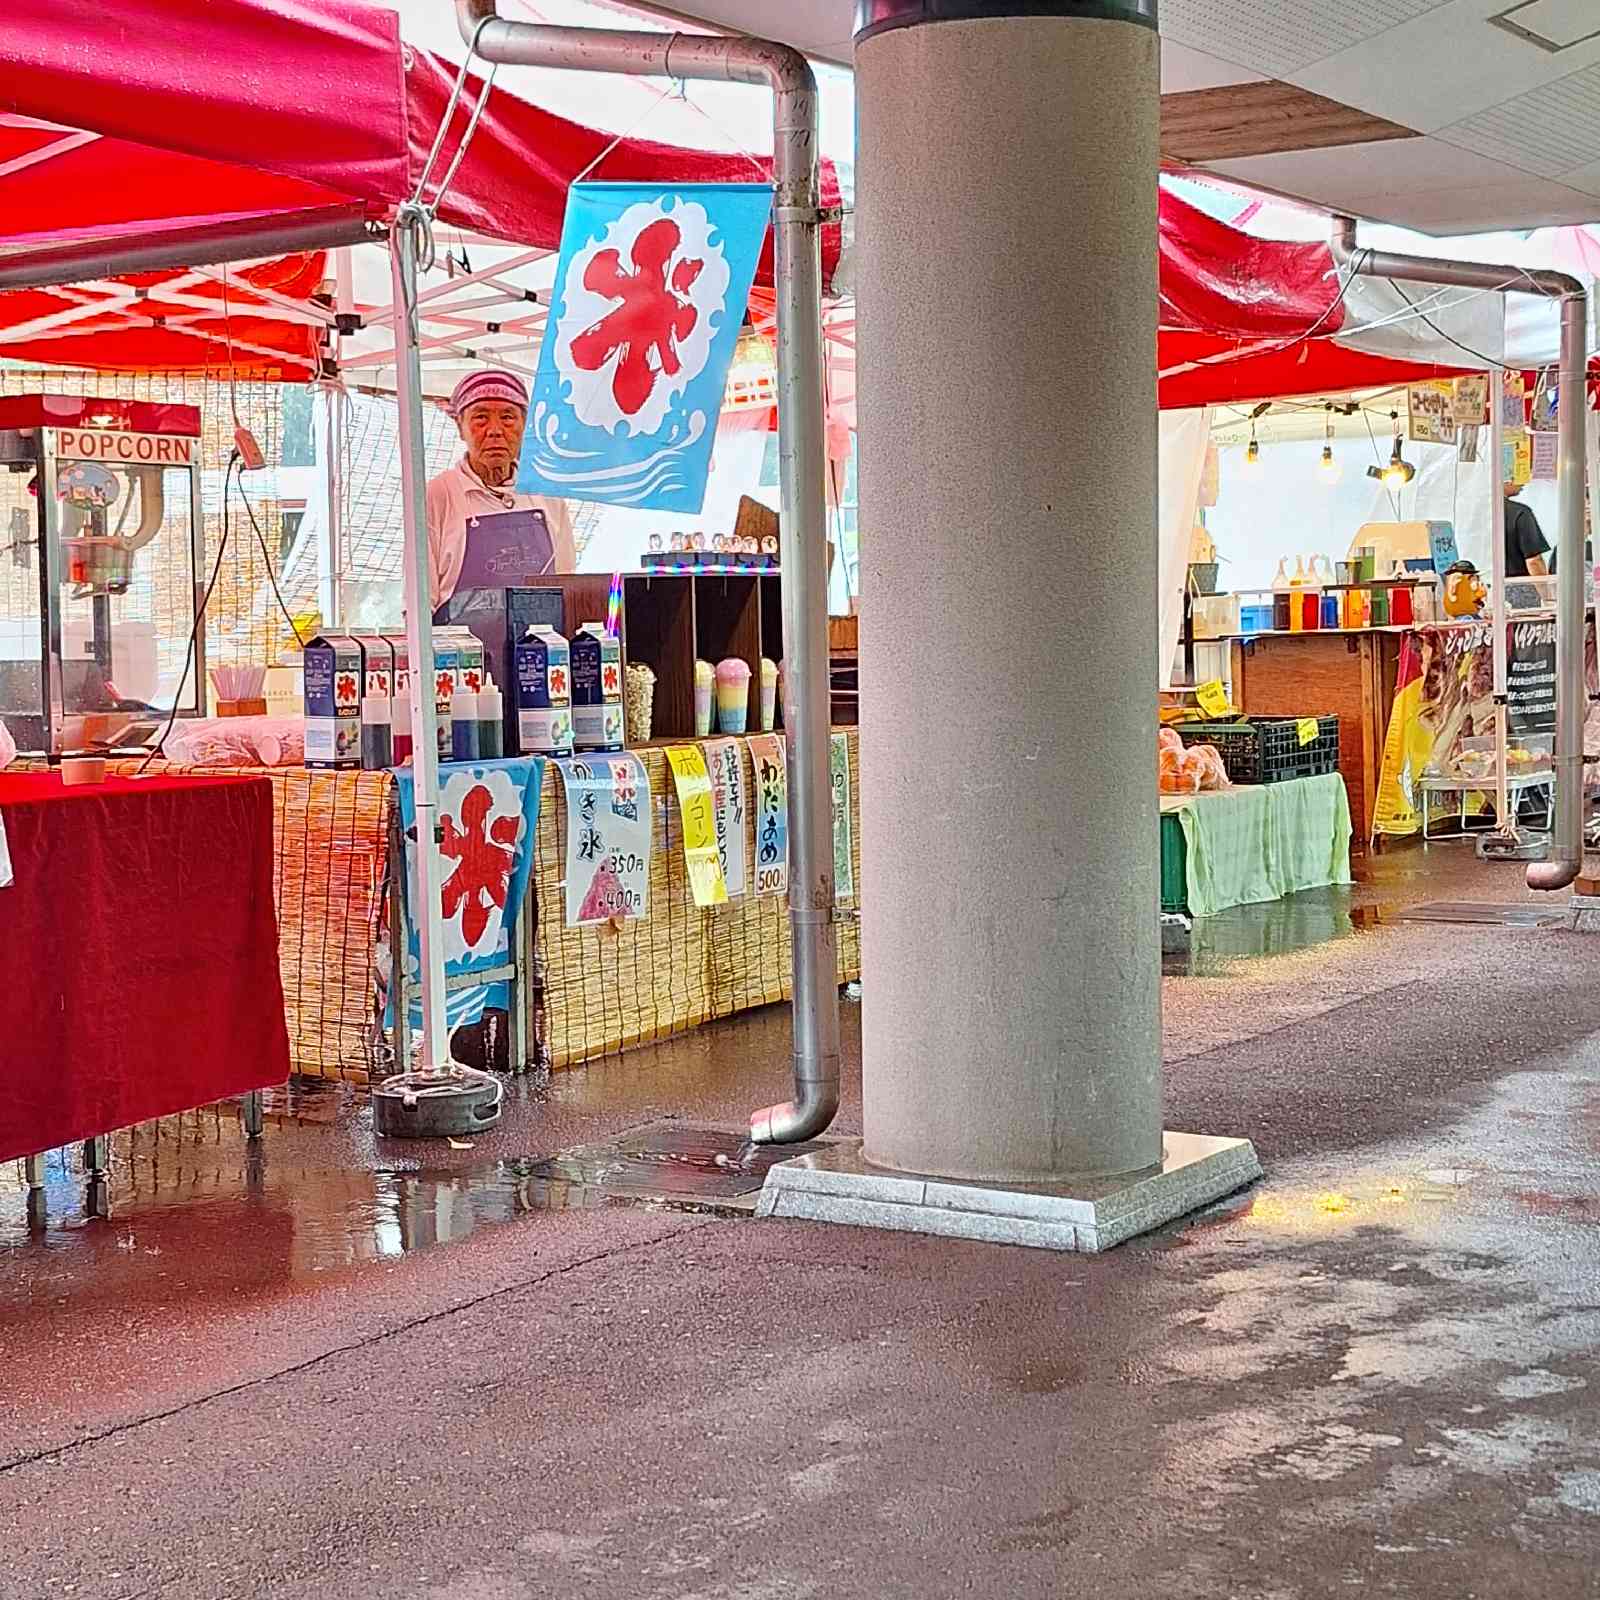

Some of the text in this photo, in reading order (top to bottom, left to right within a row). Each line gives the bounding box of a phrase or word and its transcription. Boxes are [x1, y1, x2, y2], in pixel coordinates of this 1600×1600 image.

[569, 218, 704, 415] 氷
[60, 431, 190, 462] POPCORN
[569, 761, 602, 861] かき氷
[439, 785, 520, 948] 氷
[608, 853, 645, 875] 350円
[606, 889, 641, 911] 400円
